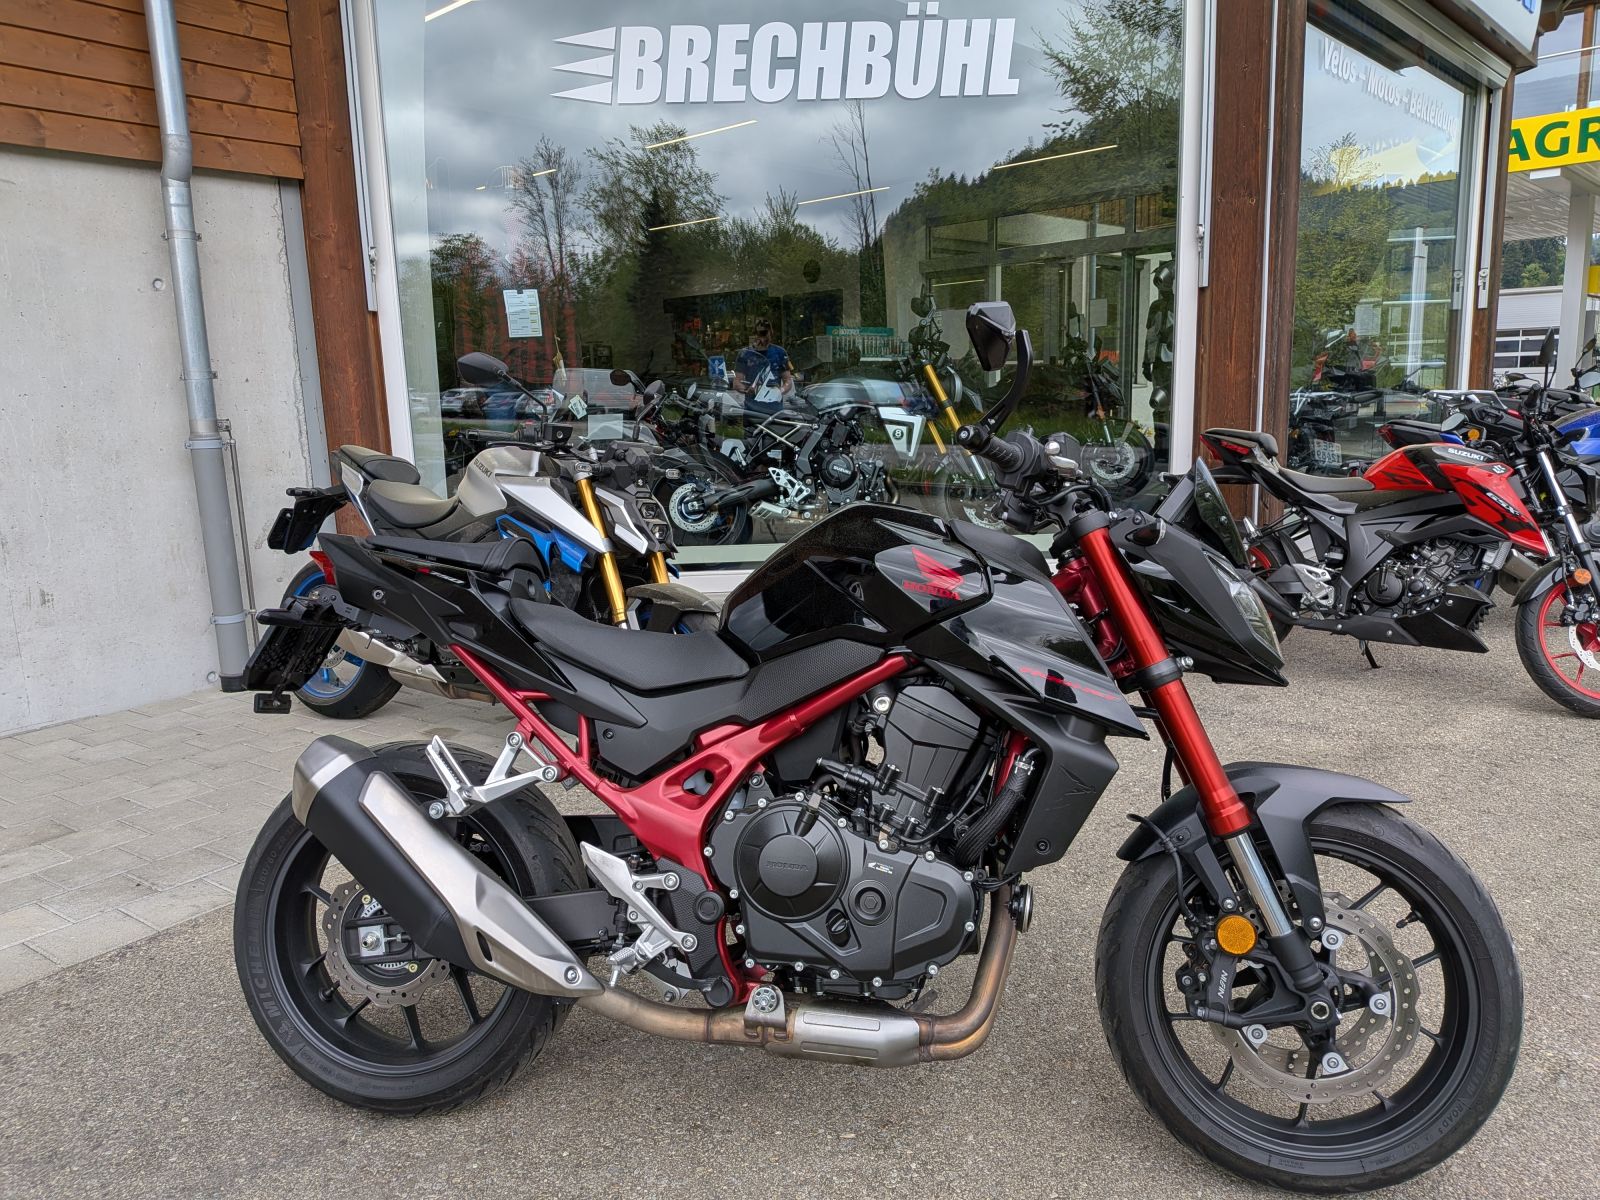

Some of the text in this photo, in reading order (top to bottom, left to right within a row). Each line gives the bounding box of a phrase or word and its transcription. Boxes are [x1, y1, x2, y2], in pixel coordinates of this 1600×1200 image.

[617, 1, 1020, 104] BRECHBÜHL
[1324, 37, 1357, 83] Velos
[1367, 68, 1400, 107] Motos
[1508, 115, 1600, 161] AGR
[1447, 447, 1485, 461] SUZUKI
[473, 458, 493, 478] SUZUKI
[833, 465, 852, 475] SUZUKI
[902, 579, 960, 601] HONDA
[765, 859, 809, 873] HONDA
[247, 894, 281, 1018] MICHELIN
[1441, 1102, 1464, 1128] ROAD
